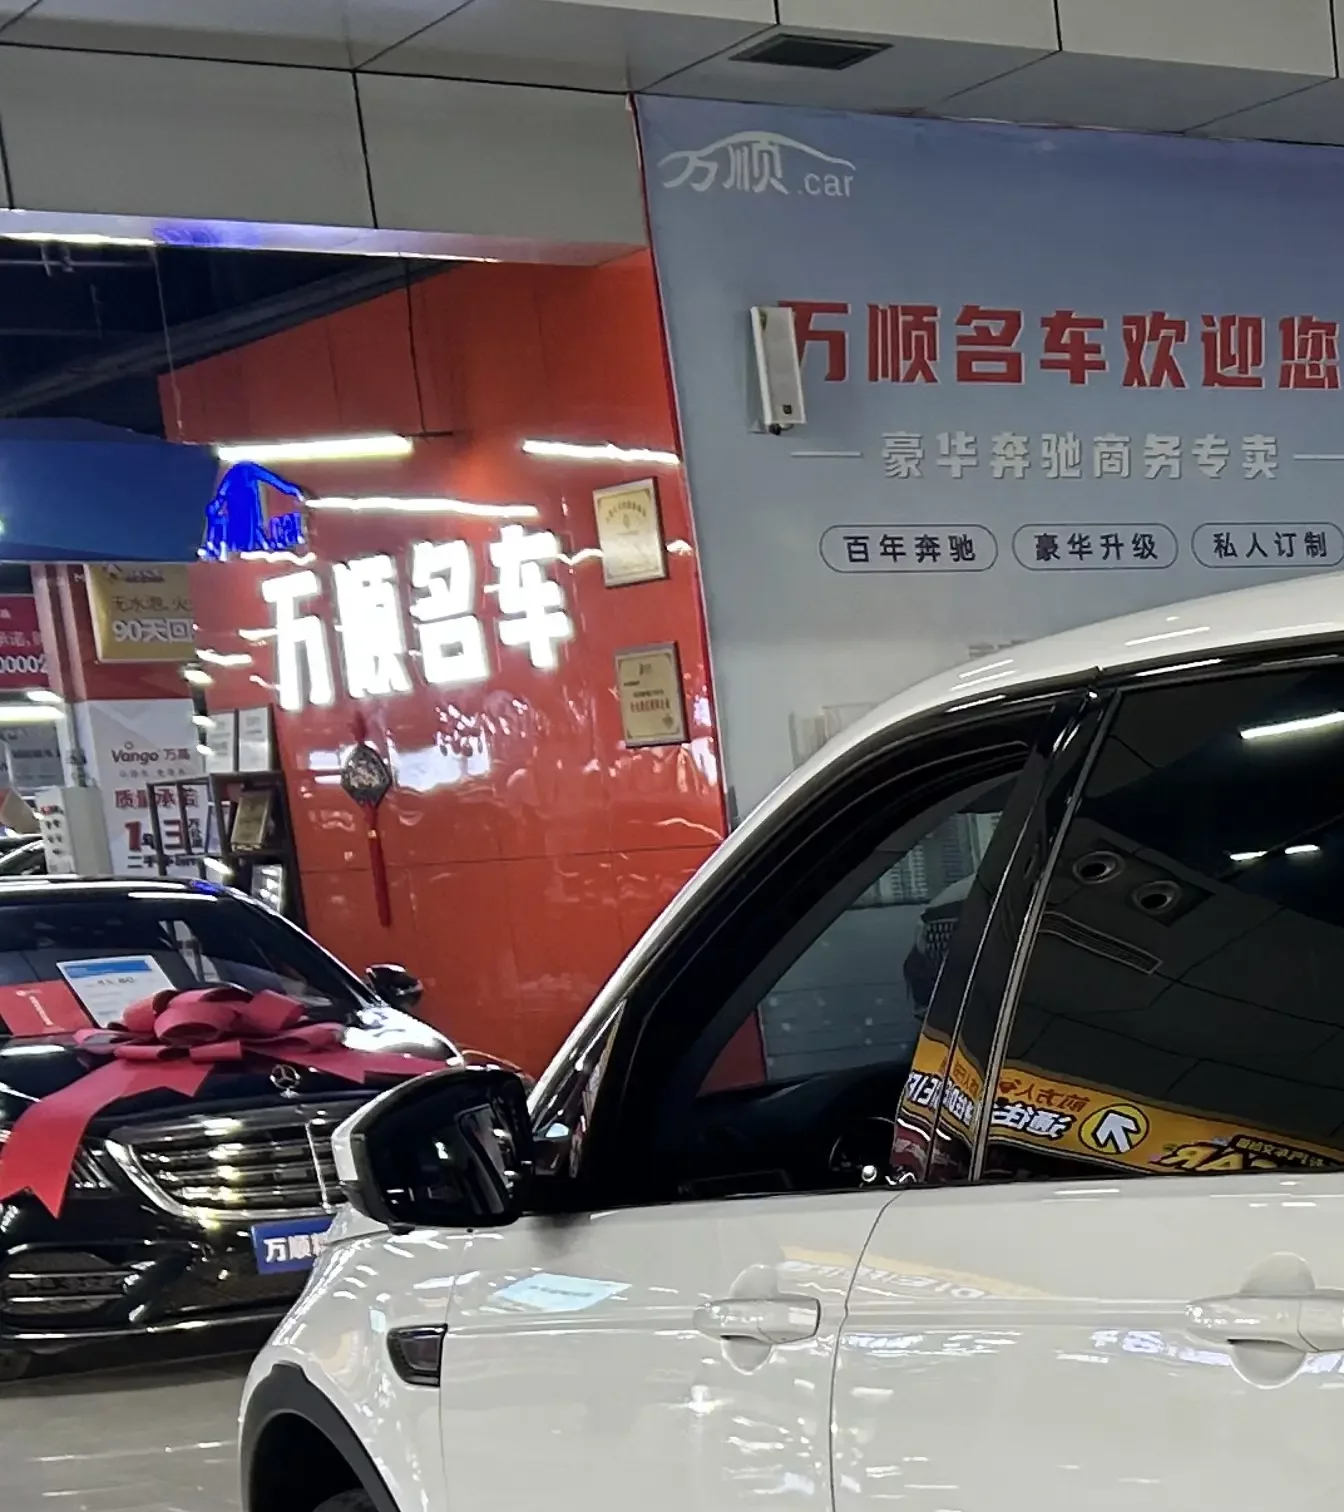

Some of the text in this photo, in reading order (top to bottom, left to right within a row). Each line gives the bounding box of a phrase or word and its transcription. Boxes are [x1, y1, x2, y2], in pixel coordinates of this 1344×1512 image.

[778, 301, 1343, 390] 万顺名车欢迎您
[881, 432, 1281, 481] 豪华奔驰商务专卖
[843, 530, 1328, 563] 百年奔驰 豪华升级 私人订制
[112, 618, 194, 643] 90天回
[111, 748, 159, 765] Vango
